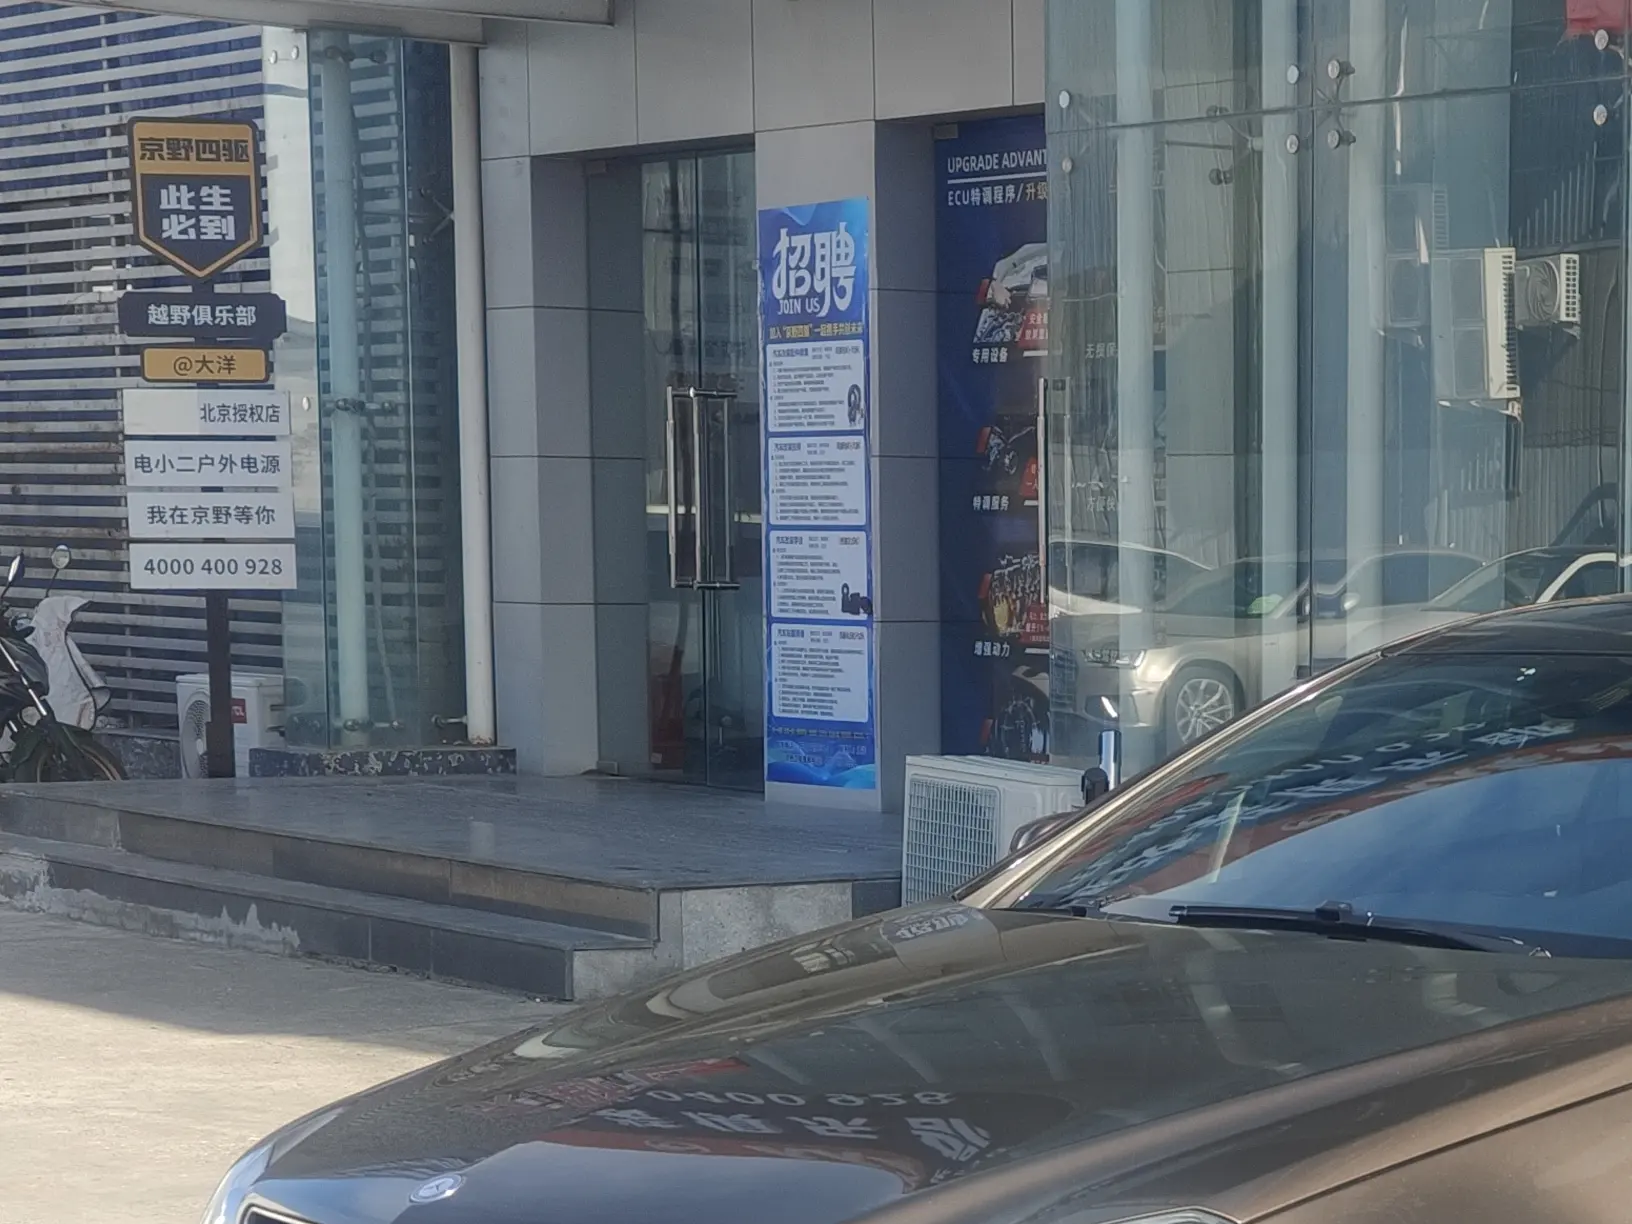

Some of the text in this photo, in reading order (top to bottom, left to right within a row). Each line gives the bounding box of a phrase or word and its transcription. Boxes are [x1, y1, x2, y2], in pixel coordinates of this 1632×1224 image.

[138, 136, 250, 164] 京野四驱
[947, 153, 1000, 174] UPGRADE
[159, 184, 235, 212] 此生
[160, 213, 236, 242] 必到
[772, 222, 857, 317] 招聘
[147, 302, 258, 328] 越野俱乐部
[778, 297, 821, 316] JOIN US
[172, 354, 237, 376] @大洋
[971, 347, 1009, 364] 专用设备
[199, 401, 282, 425] 北京授权店
[133, 453, 282, 476] 电小二户外电源
[146, 503, 277, 527] 我在京野等你
[143, 558, 284, 577] 4000 400 928
[973, 641, 1010, 658] 增强动力
